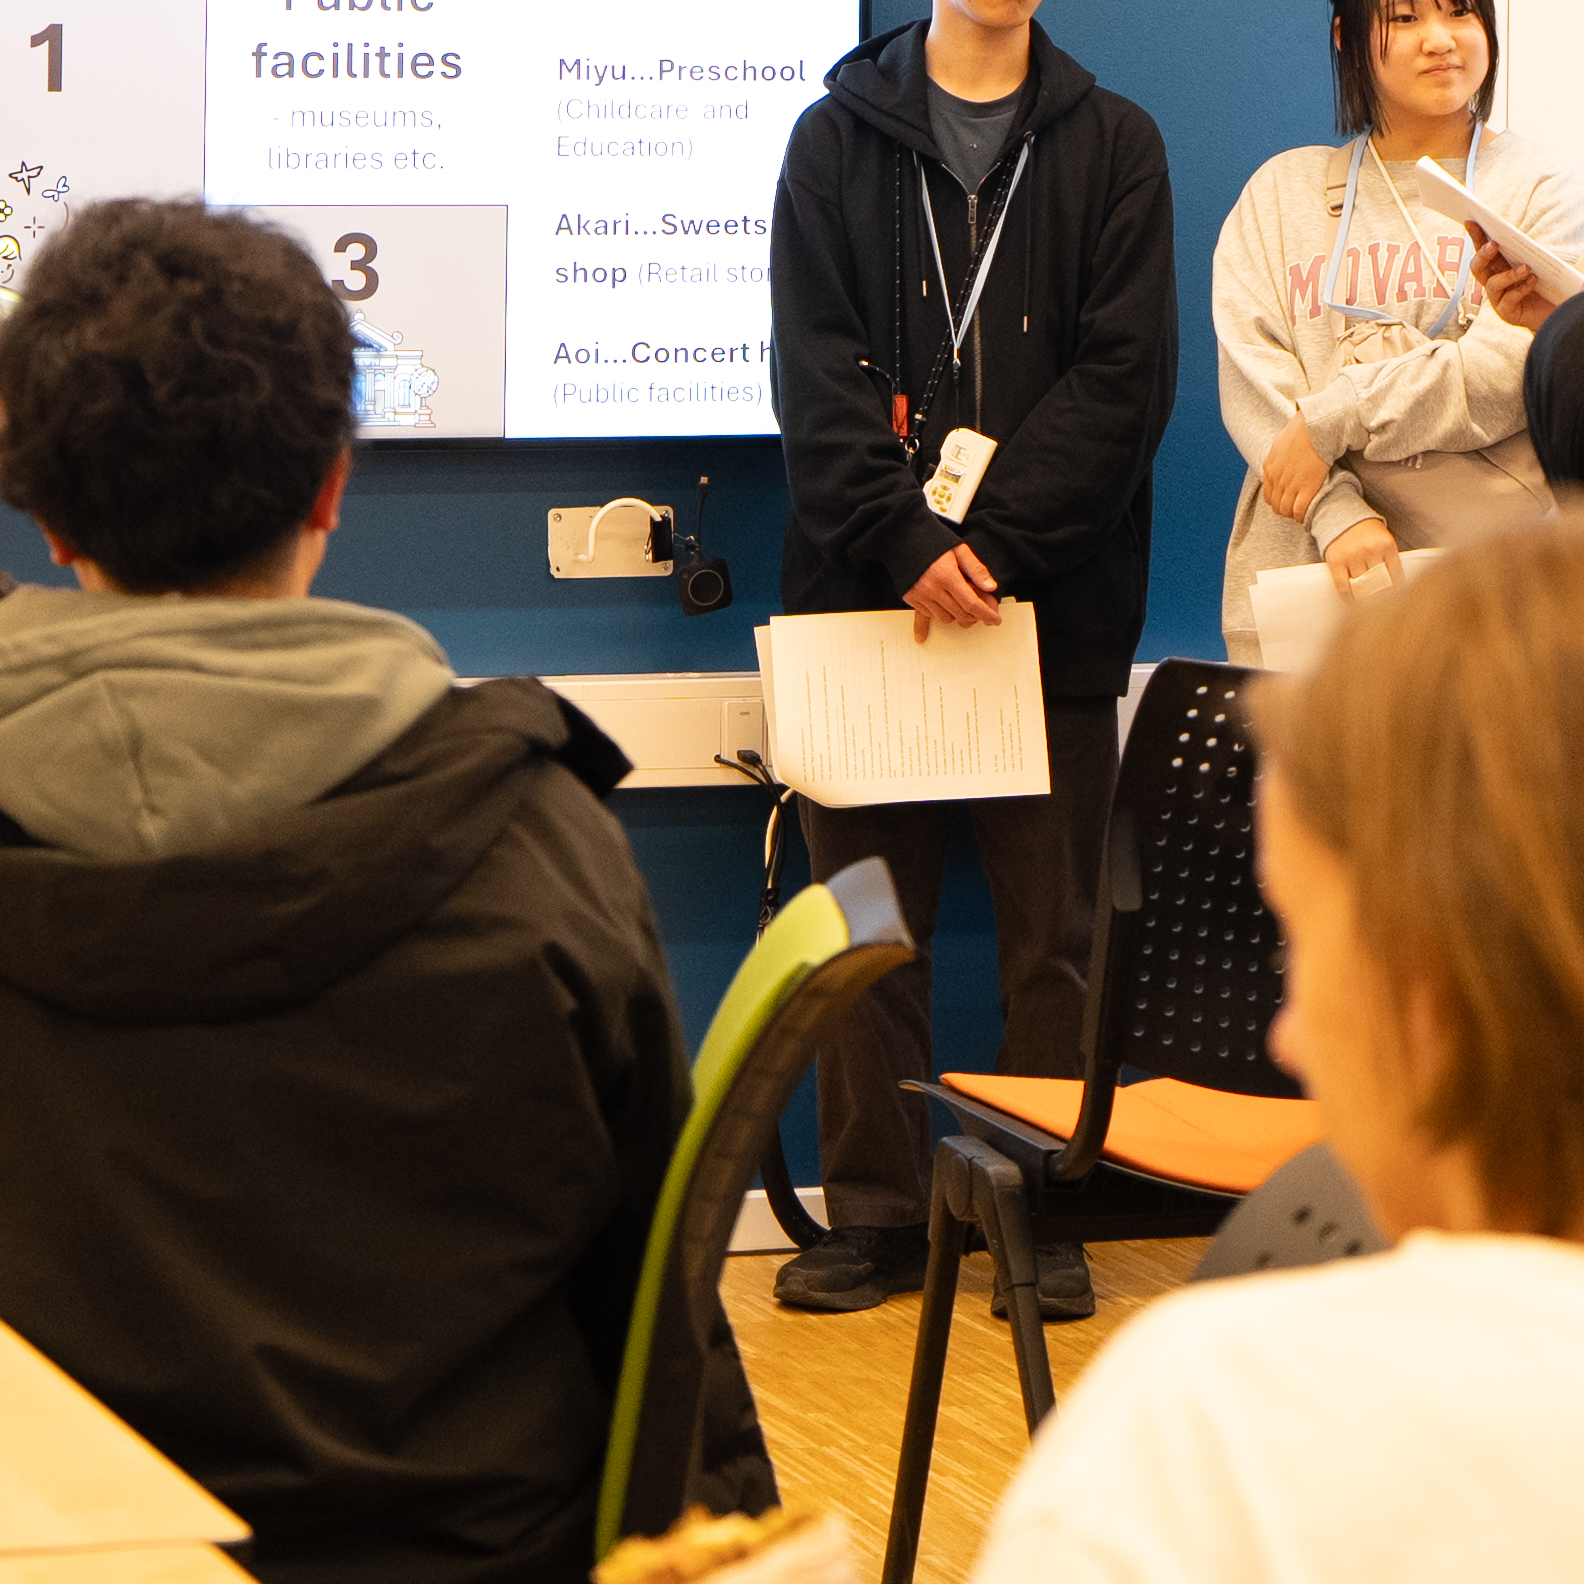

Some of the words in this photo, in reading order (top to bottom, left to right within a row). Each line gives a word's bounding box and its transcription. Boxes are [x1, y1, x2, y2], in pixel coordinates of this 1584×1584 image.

[30, 24, 62, 92] 1
[252, 42, 461, 79] facilities
[292, 111, 440, 129] museums,
[558, 99, 687, 121] (Childcare
[704, 100, 748, 119] and
[269, 146, 382, 169] libraries
[394, 149, 443, 169] etc.
[558, 136, 692, 160] Education)
[331, 233, 379, 301] 3
[556, 262, 626, 289] shop
[639, 263, 717, 287] (Retail
[727, 265, 771, 283] stor
[554, 383, 638, 406] (Public
[648, 382, 761, 406] facilities)
